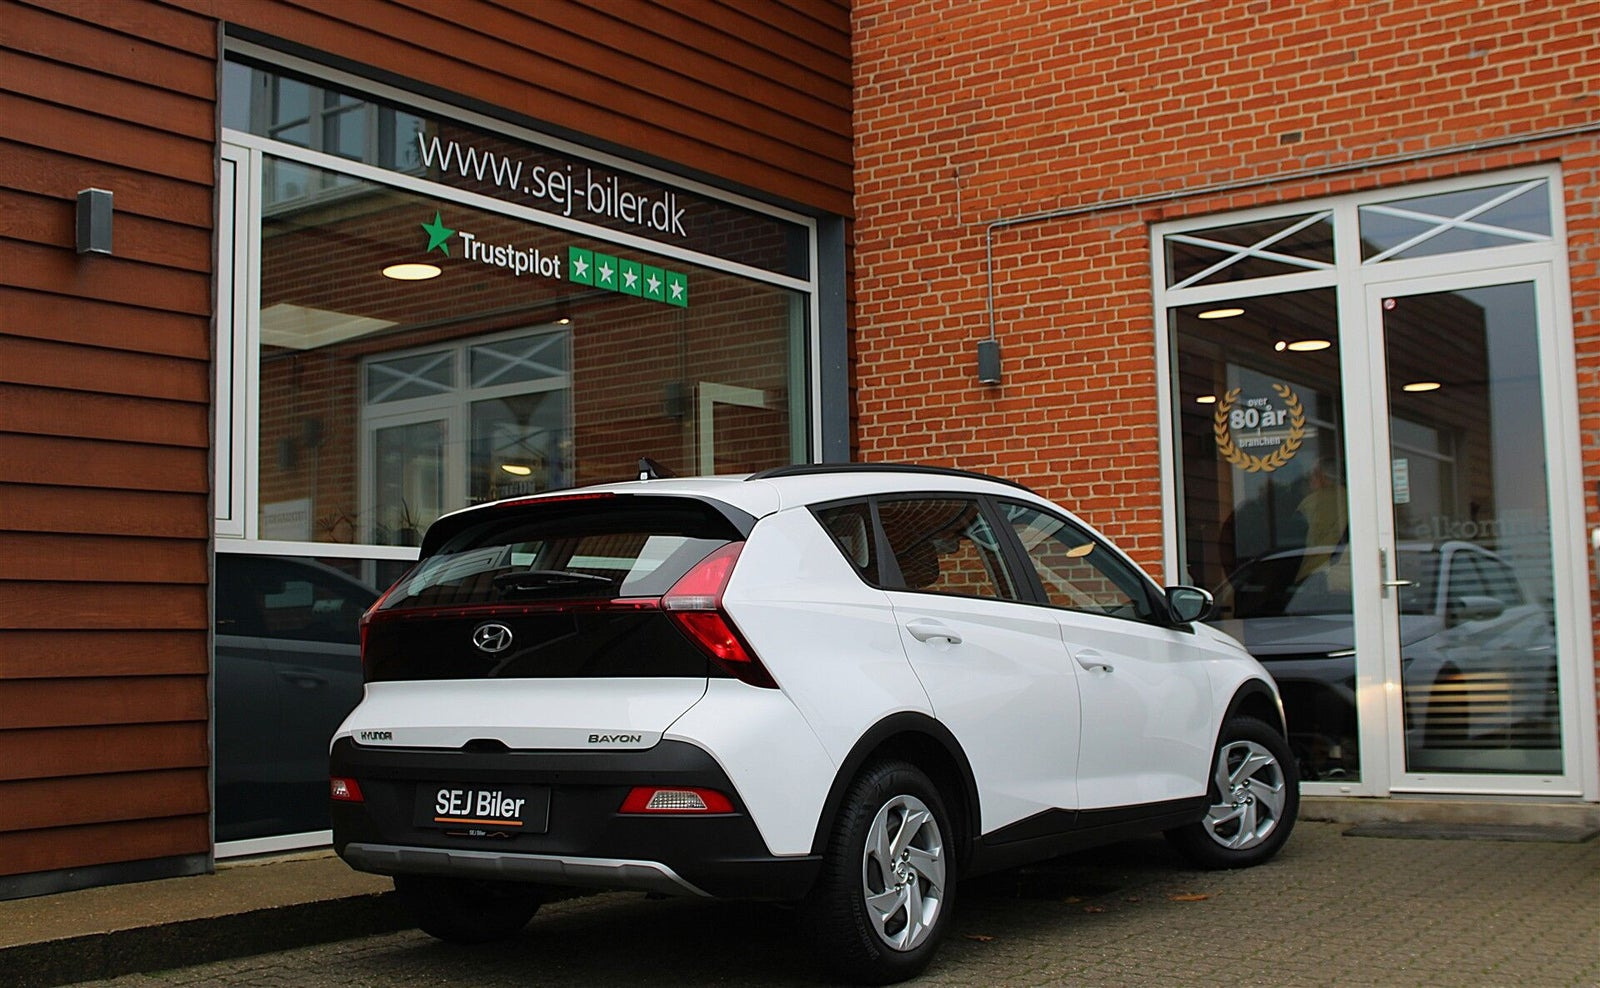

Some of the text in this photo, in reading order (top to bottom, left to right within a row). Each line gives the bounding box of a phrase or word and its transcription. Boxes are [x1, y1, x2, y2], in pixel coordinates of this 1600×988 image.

[418, 132, 687, 237] www.sej-biler.dk
[459, 231, 561, 279] Trustpilot
[1248, 397, 1268, 407] over
[1231, 404, 1287, 429] 80 år
[1239, 436, 1281, 448] branchen
[360, 731, 393, 740] HYUNDAI
[587, 734, 642, 743] BAYON
[435, 789, 525, 818] SEJ Biler
